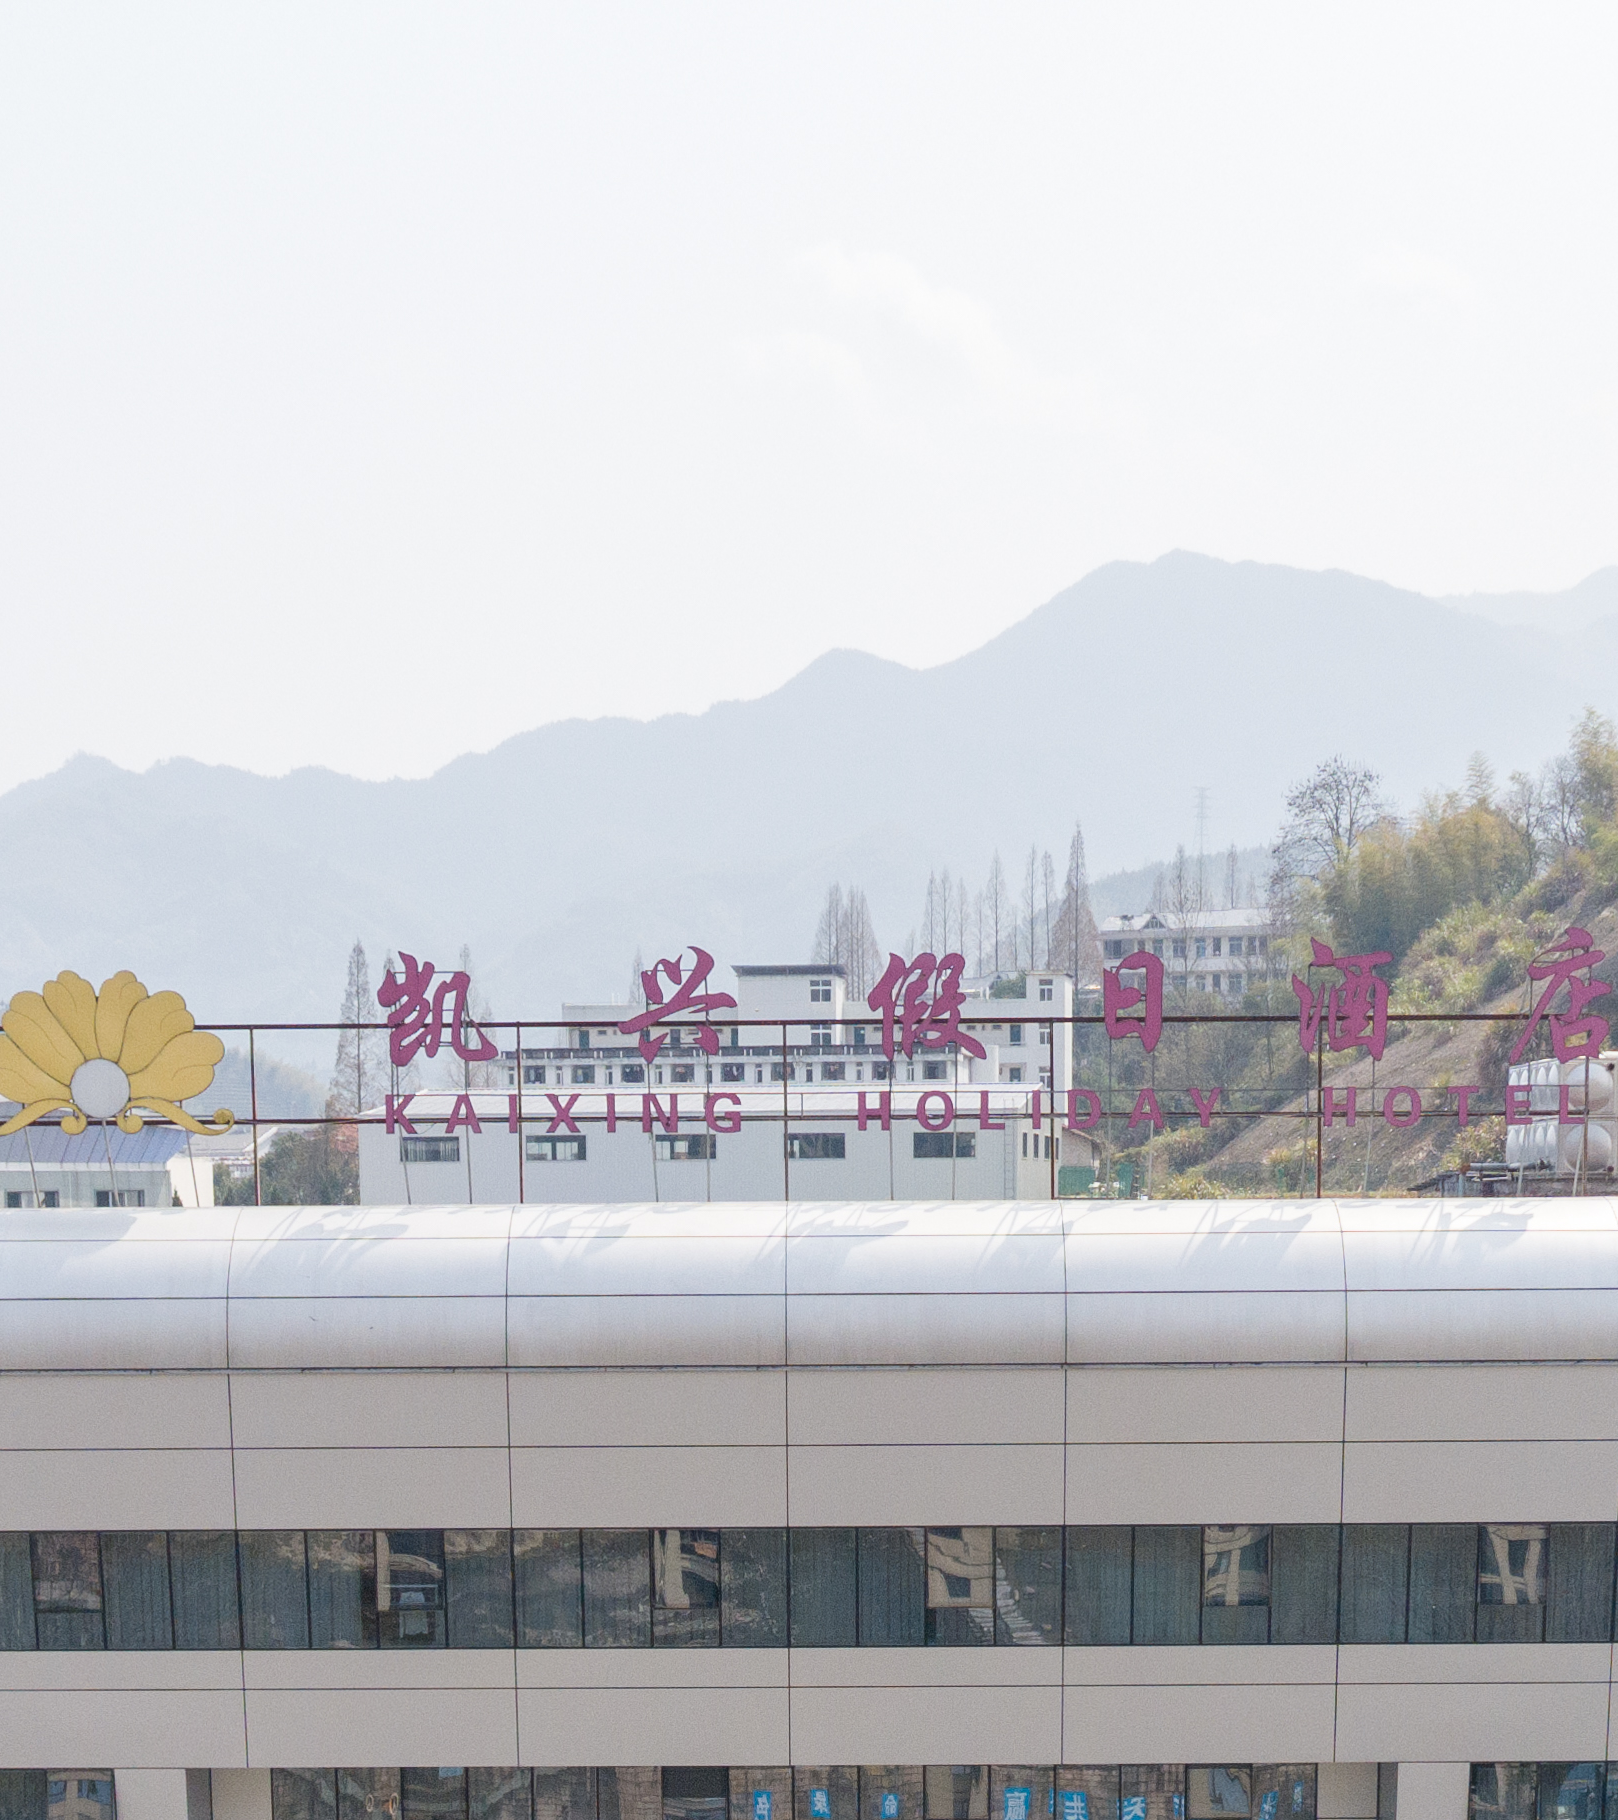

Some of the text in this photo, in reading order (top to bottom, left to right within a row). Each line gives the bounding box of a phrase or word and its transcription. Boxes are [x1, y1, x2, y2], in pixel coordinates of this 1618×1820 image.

[377, 927, 1612, 1067] 凯兴假日酒店
[385, 1085, 1587, 1134] KAIXING HOLIDAY HOTEL
